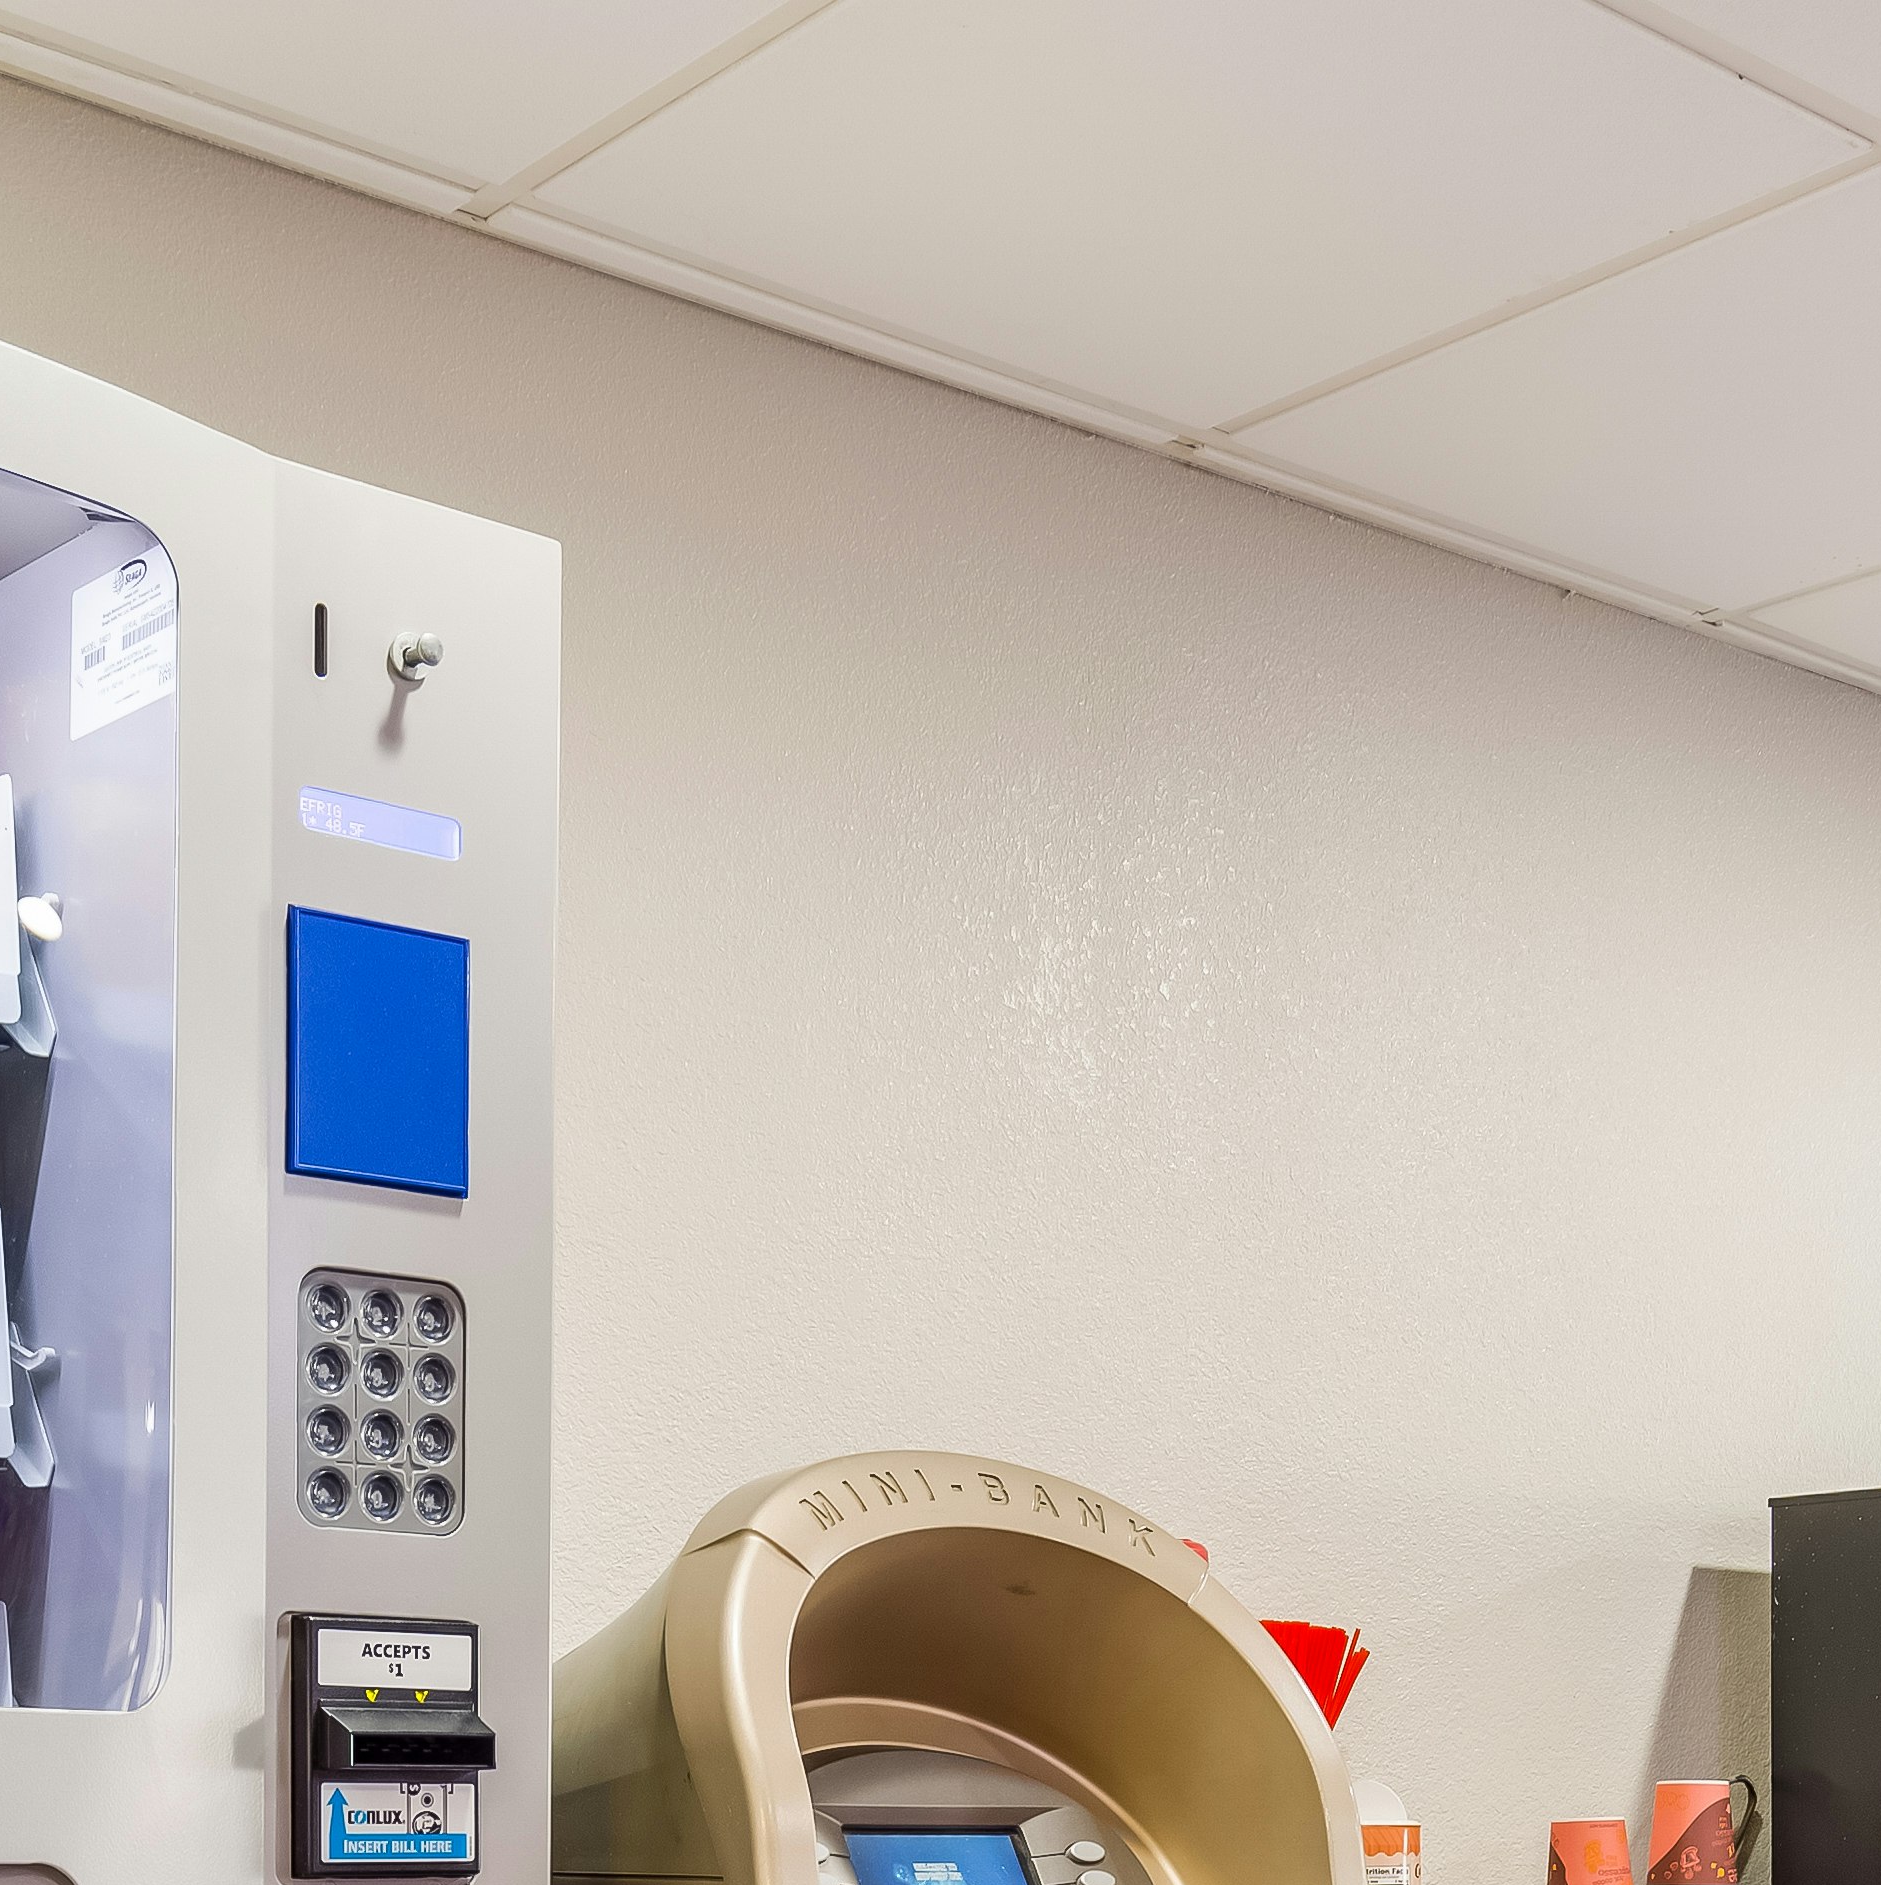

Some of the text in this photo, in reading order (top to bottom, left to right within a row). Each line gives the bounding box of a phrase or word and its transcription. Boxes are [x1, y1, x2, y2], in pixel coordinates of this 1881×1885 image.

[799, 1468, 1157, 1558] MINI-BANK
[361, 1643, 431, 1660] ACCEPTS
[388, 1662, 404, 1678] $1
[347, 1809, 403, 1825] CONLUX
[343, 1839, 452, 1854] INSERT BILL HERE
